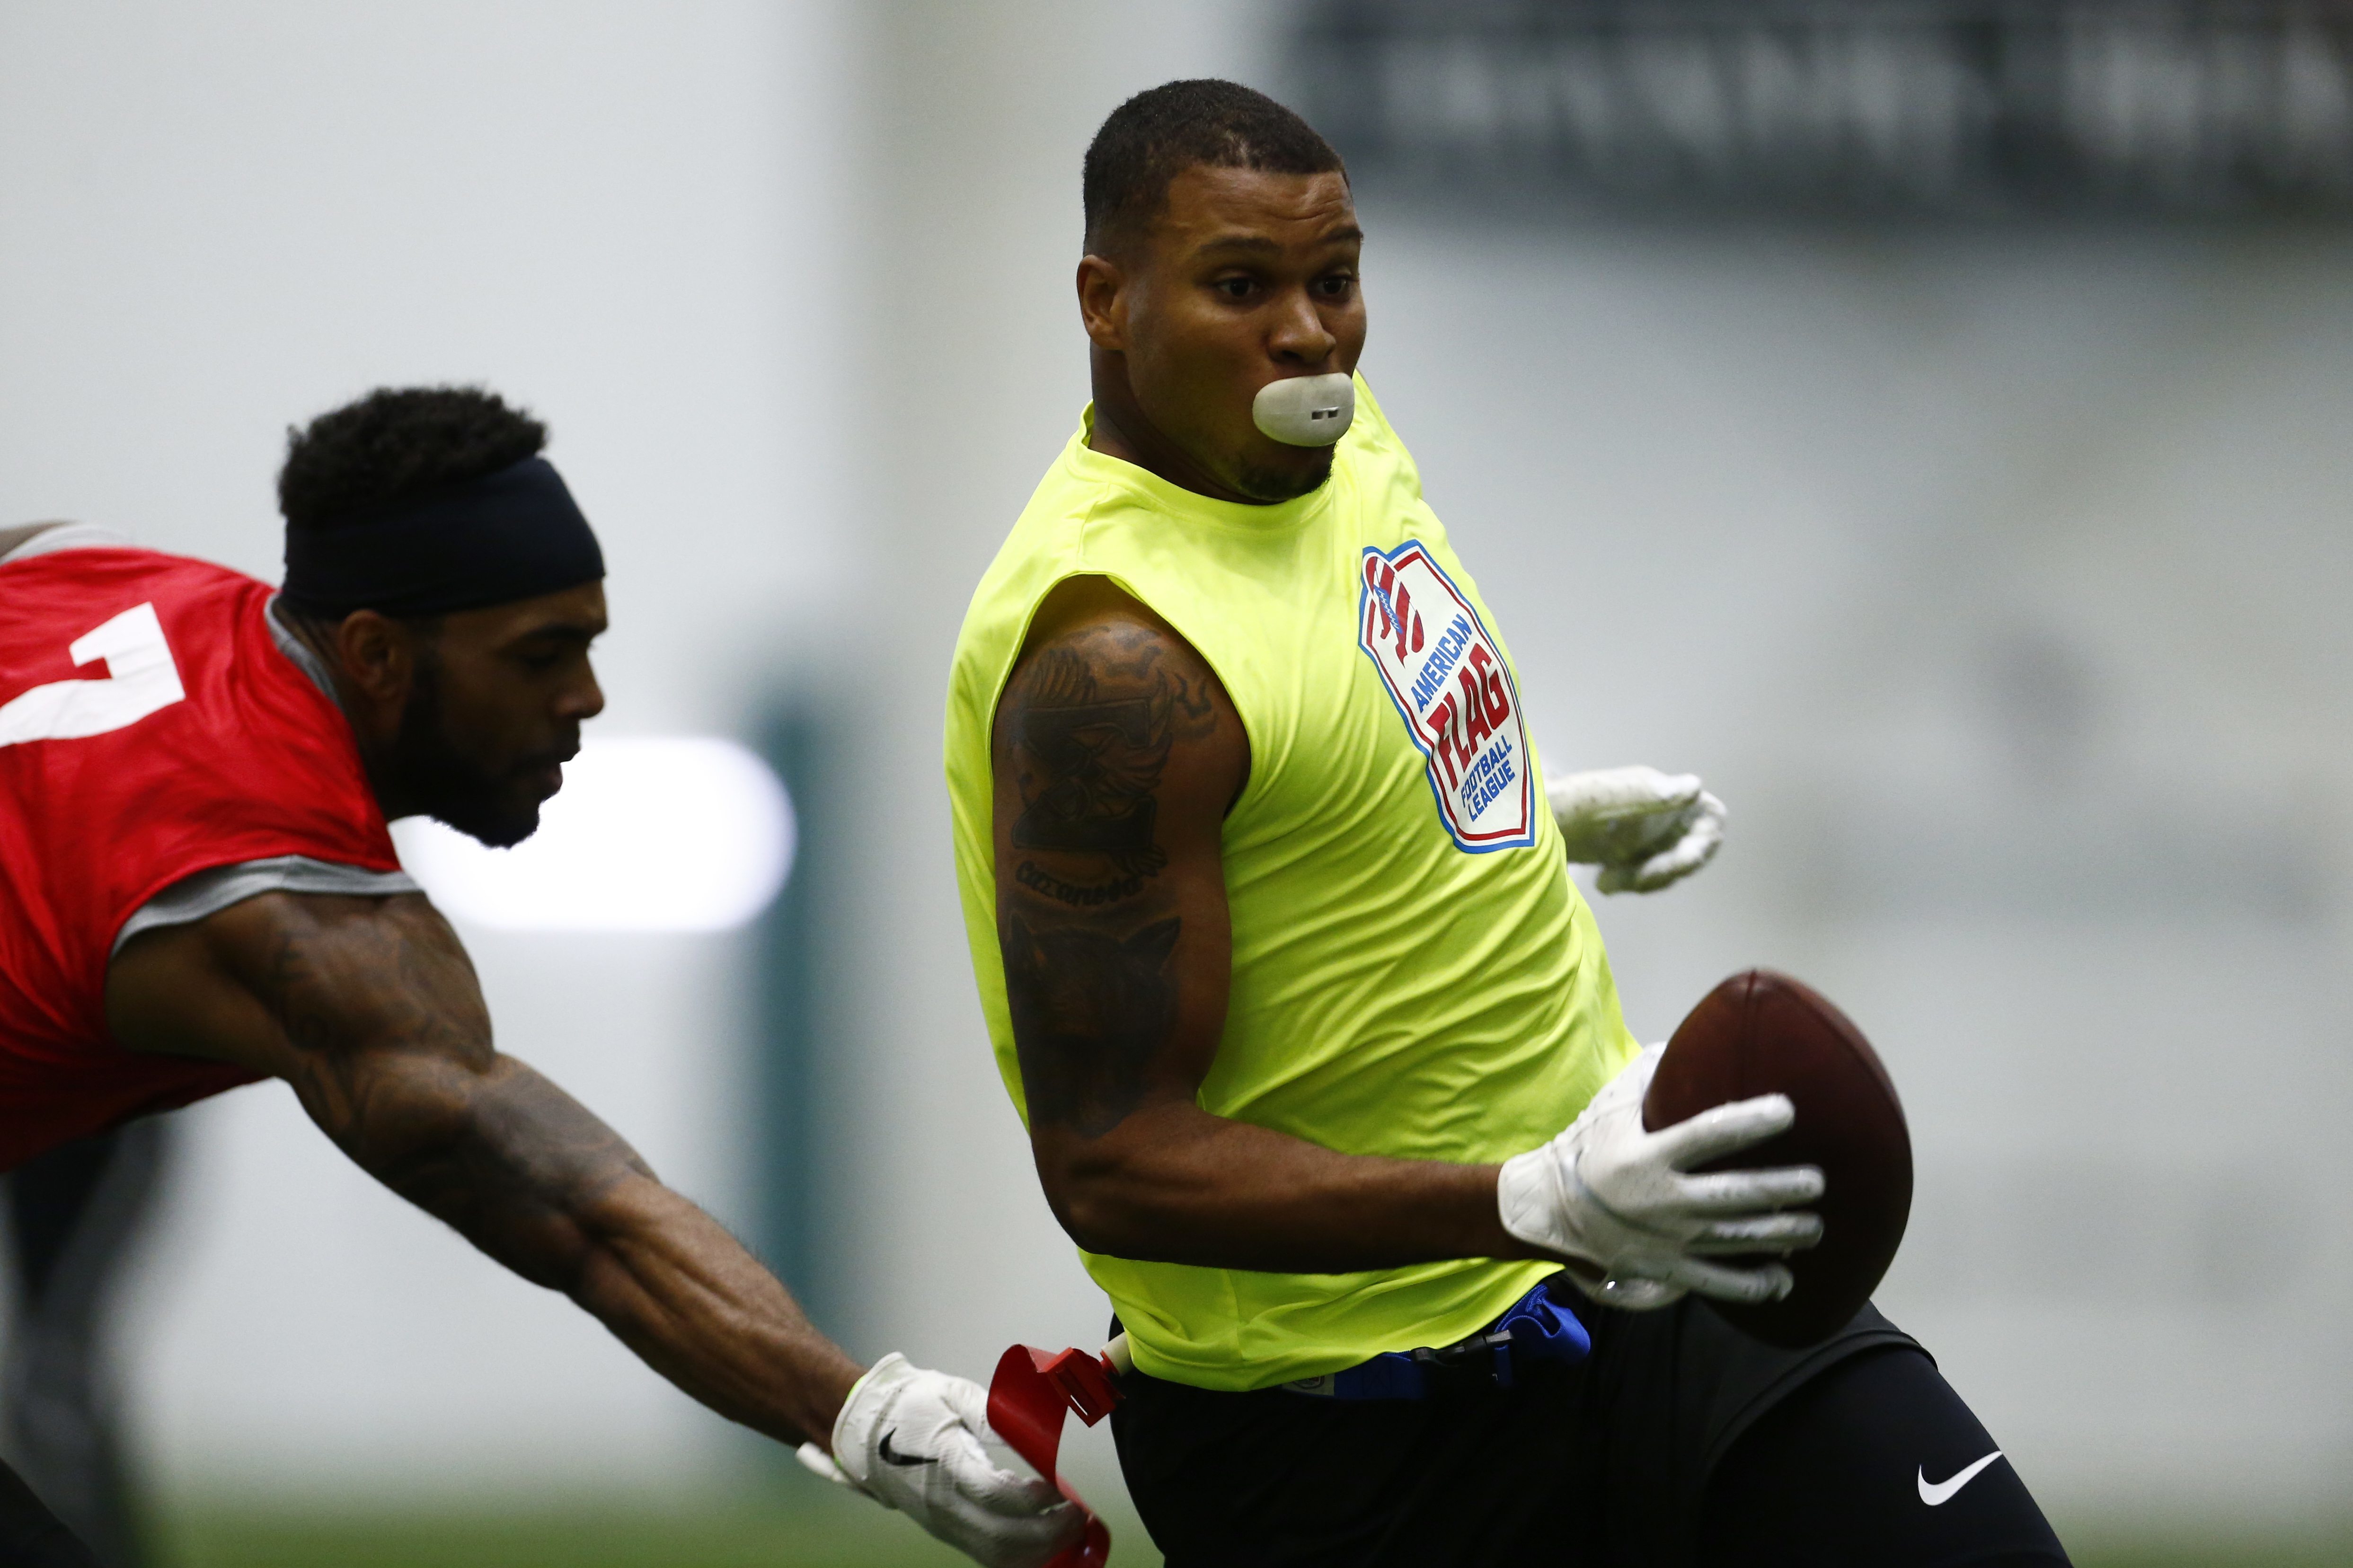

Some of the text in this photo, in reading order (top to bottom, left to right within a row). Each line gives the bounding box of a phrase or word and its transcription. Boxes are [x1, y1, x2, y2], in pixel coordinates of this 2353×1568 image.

[1411, 614, 1472, 714] AMERICAN
[1426, 643, 1510, 793] FLAG
[1461, 734, 1512, 808] FOOTBALL
[1468, 759, 1515, 822] LEAGUE
